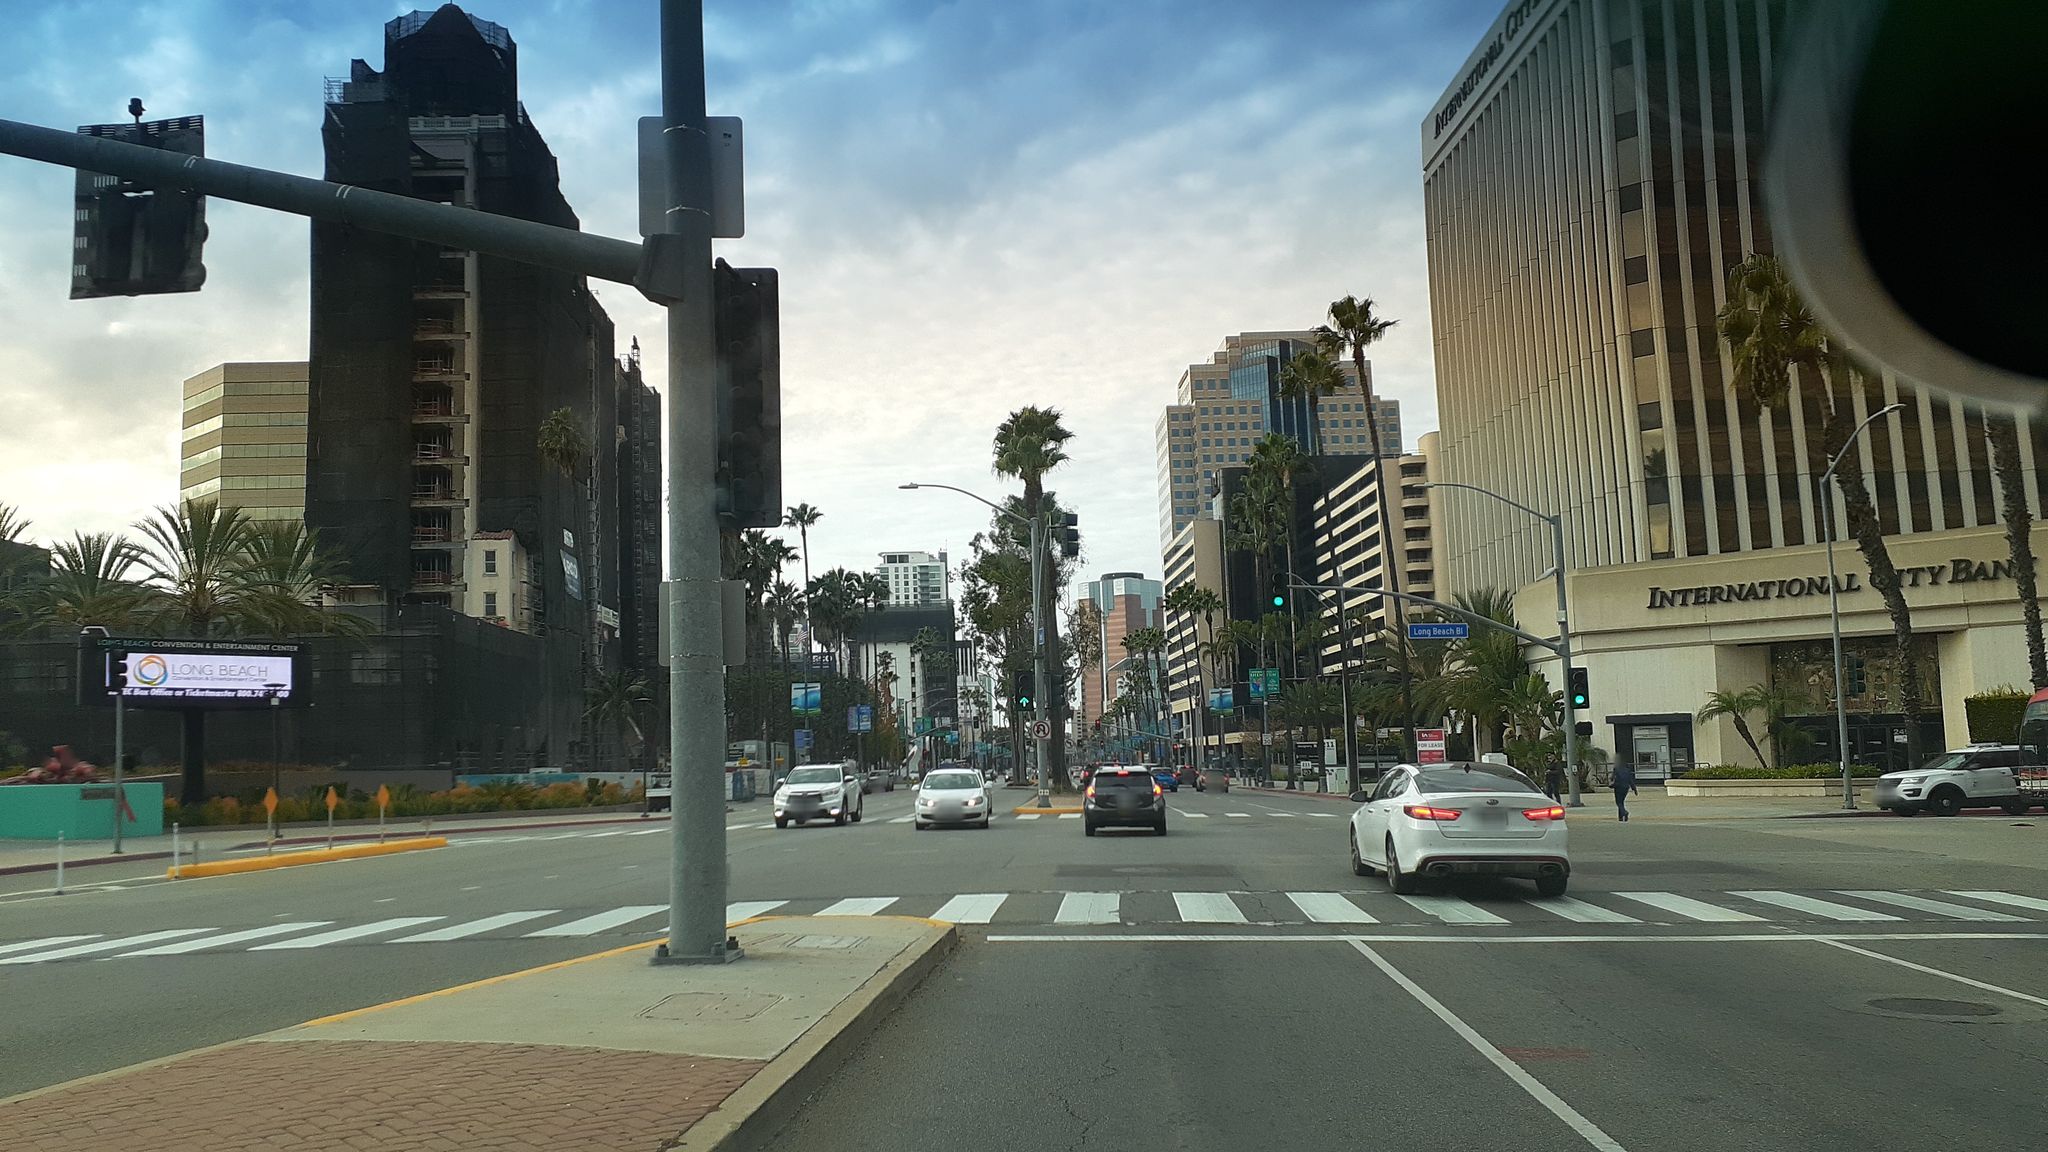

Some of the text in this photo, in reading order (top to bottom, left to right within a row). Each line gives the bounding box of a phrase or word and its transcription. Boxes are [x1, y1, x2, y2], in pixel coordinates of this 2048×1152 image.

[1647, 573, 1861, 609] INTERNATIONAL
[1948, 556, 2038, 584] BAN
[1413, 627, 1431, 637] Long
[1432, 627, 1455, 635] Beach
[151, 641, 204, 649] CONVENTION
[212, 643, 270, 651] ENTERTAINMENT
[271, 644, 299, 652] CENTER
[172, 663, 268, 677] LONG BEACH
[133, 688, 149, 696] Box
[149, 688, 173, 696] Office
[184, 689, 237, 697] Ticketmaster
